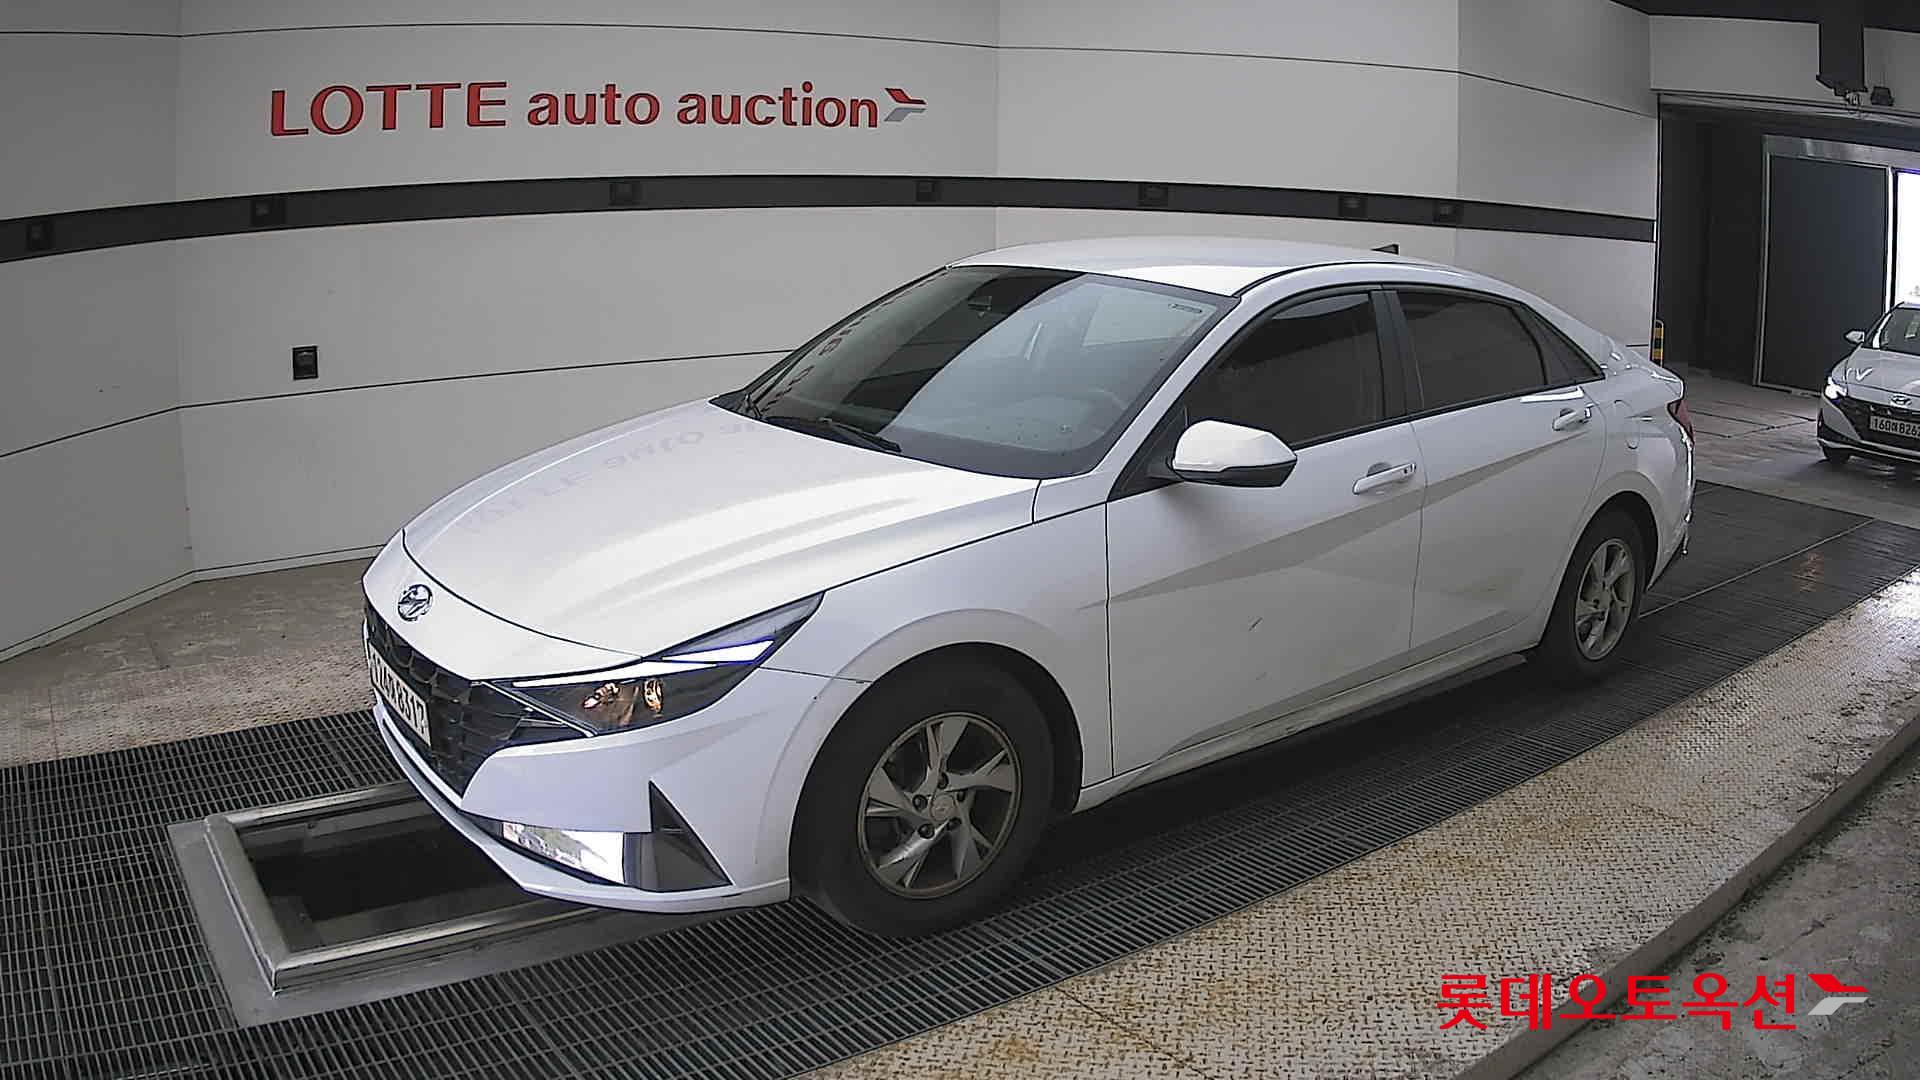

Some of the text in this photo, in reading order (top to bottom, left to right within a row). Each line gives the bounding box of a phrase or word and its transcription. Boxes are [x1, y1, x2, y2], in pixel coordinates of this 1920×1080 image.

[270, 81, 878, 136] LOTTE auto auction
